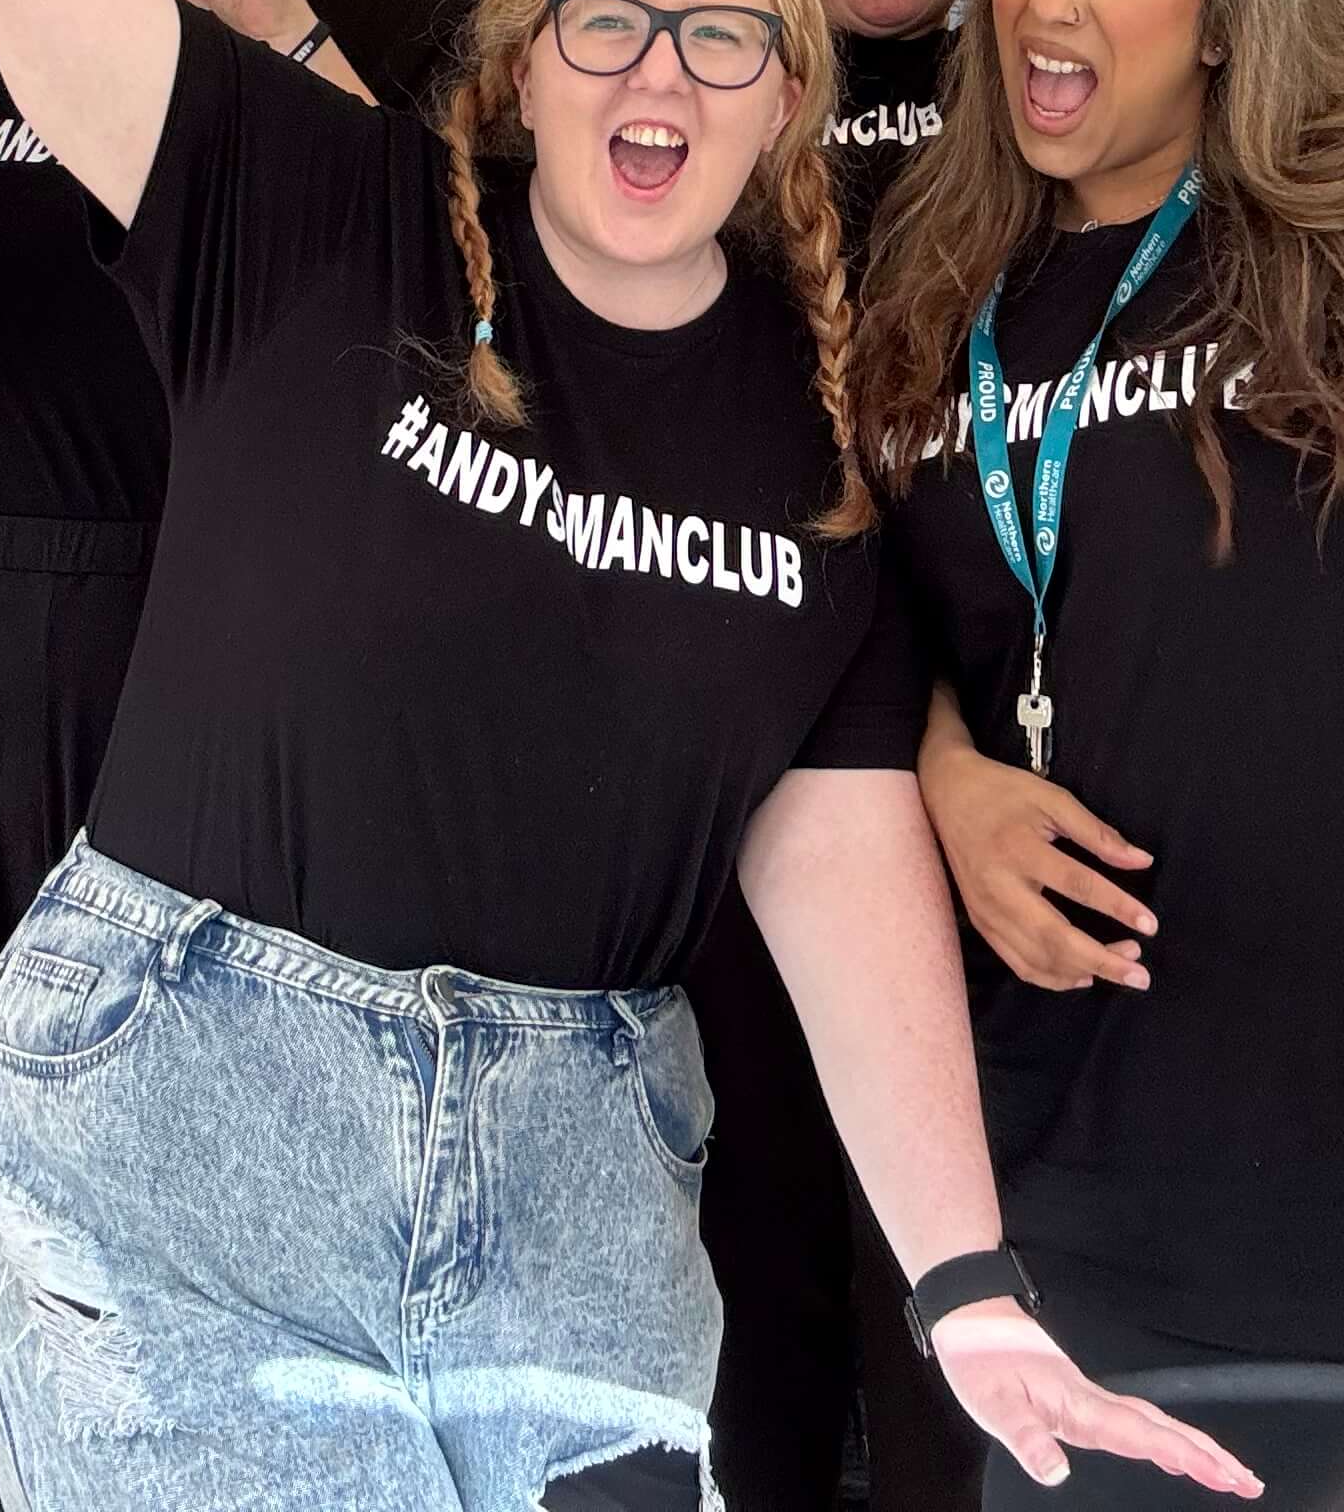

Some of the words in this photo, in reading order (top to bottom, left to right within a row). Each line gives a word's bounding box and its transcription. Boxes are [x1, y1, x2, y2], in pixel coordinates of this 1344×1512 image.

[821, 100, 944, 147] NCLUB
[1177, 165, 1204, 206] PRO
[1129, 232, 1161, 280] Northern
[978, 360, 997, 423] PROUD
[1059, 342, 1097, 411] PROUD
[381, 394, 804, 609] #ANDYSMANCLUB
[1037, 459, 1052, 521] Northern
[1047, 460, 1061, 523] Healthcare
[1001, 501, 1022, 562] Northern
